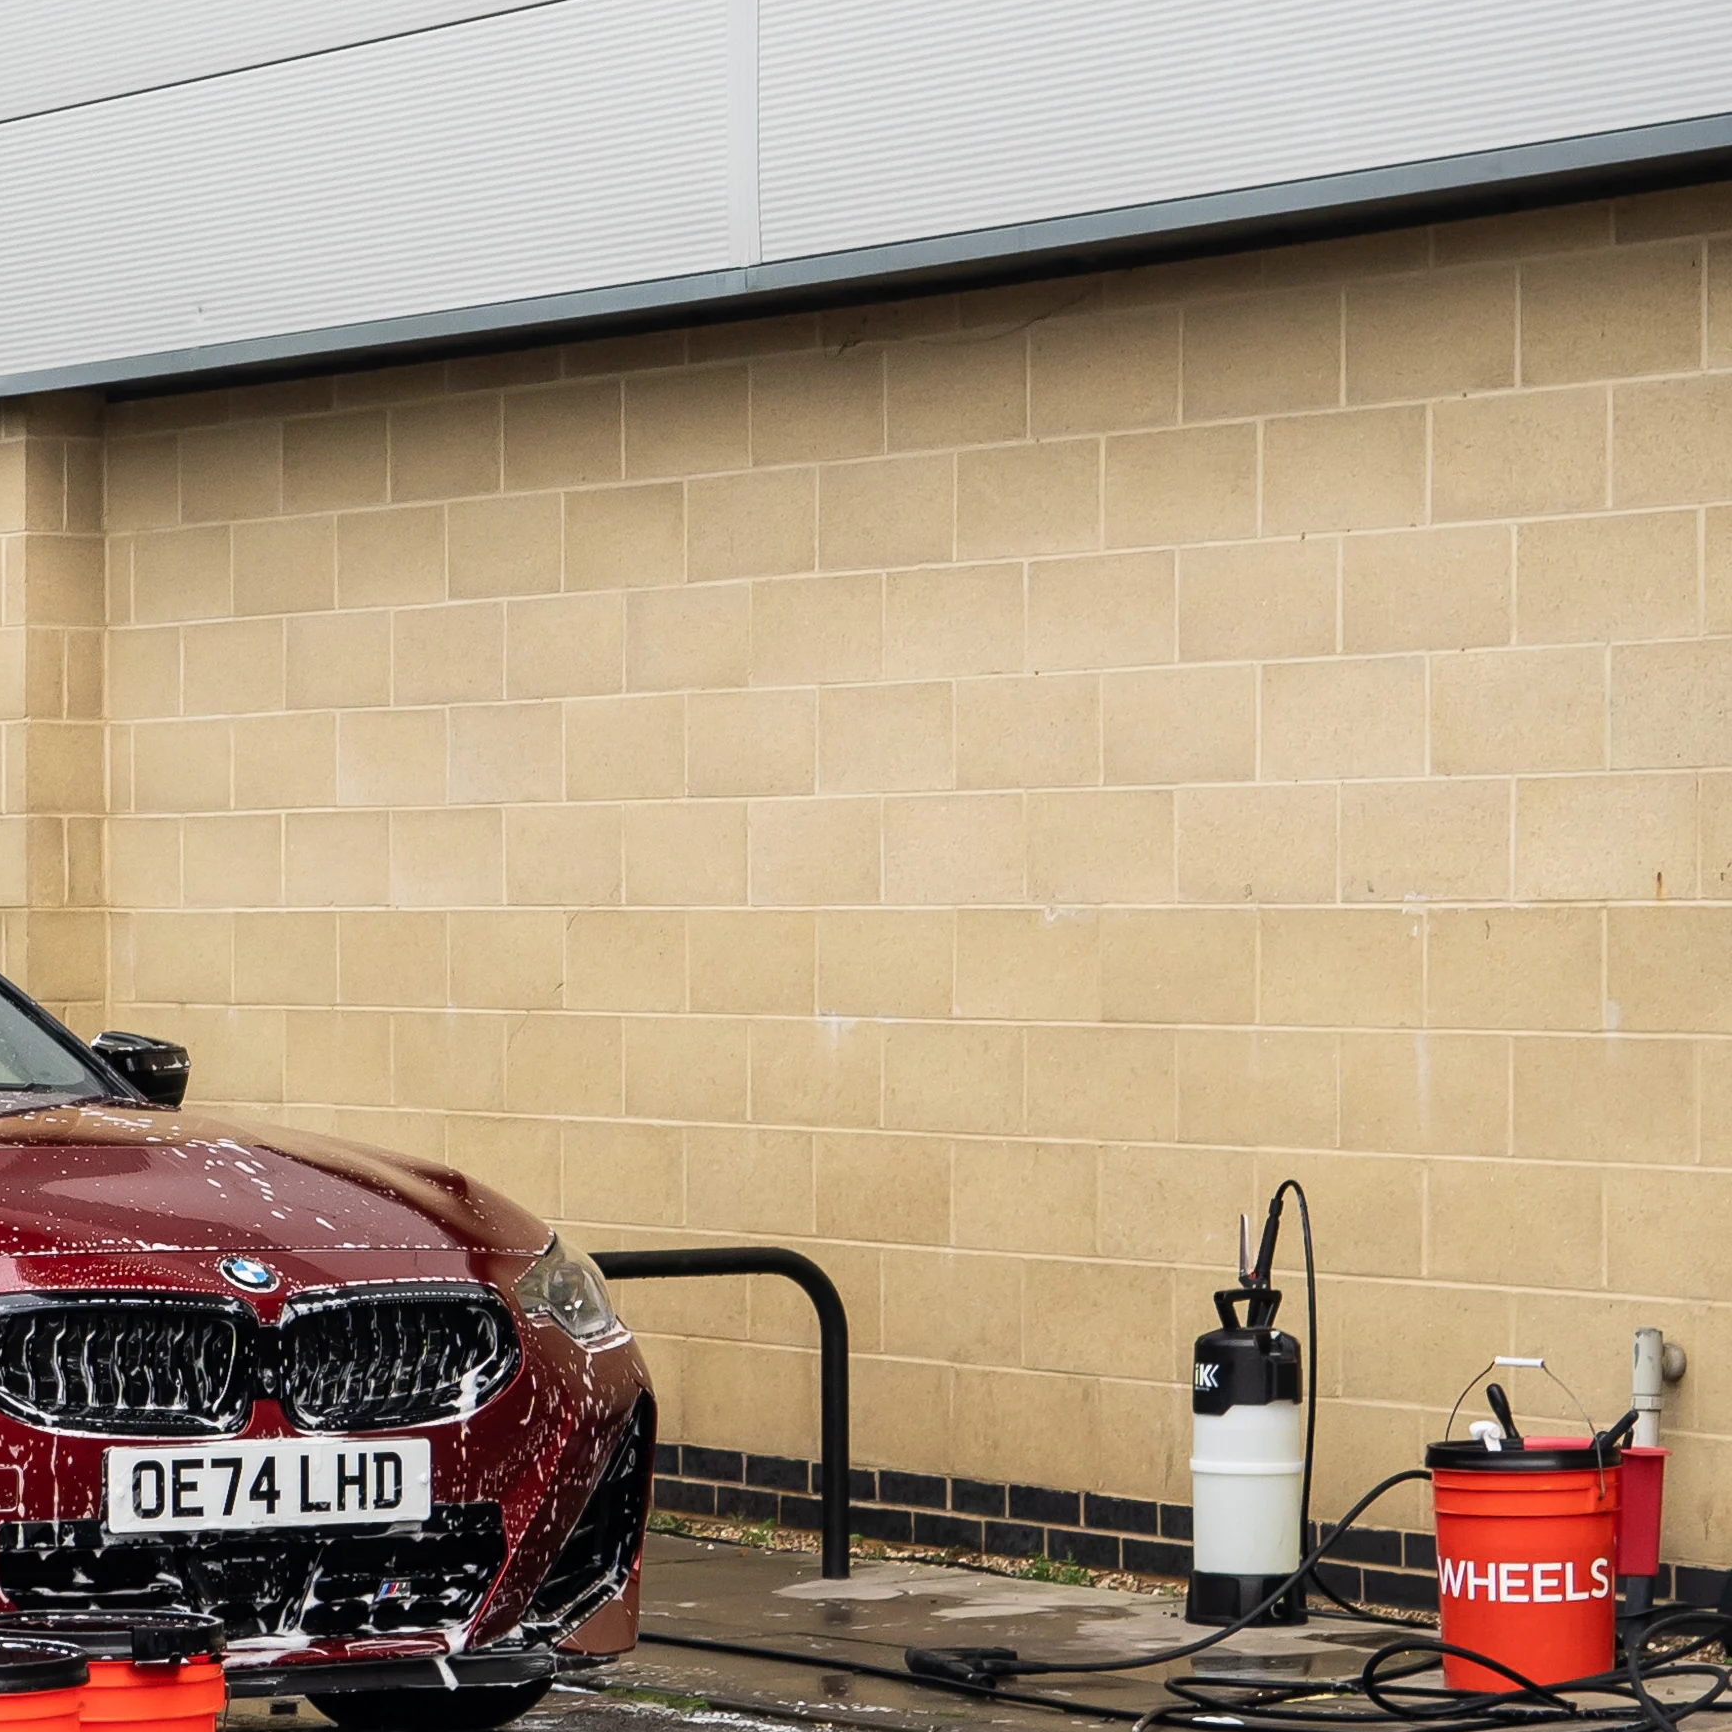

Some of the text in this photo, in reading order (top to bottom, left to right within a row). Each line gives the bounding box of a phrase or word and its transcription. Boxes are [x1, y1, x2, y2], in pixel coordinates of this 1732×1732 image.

[132, 1451, 403, 1519] OE74 LHD
[1437, 1555, 1609, 1602] WHEELS
